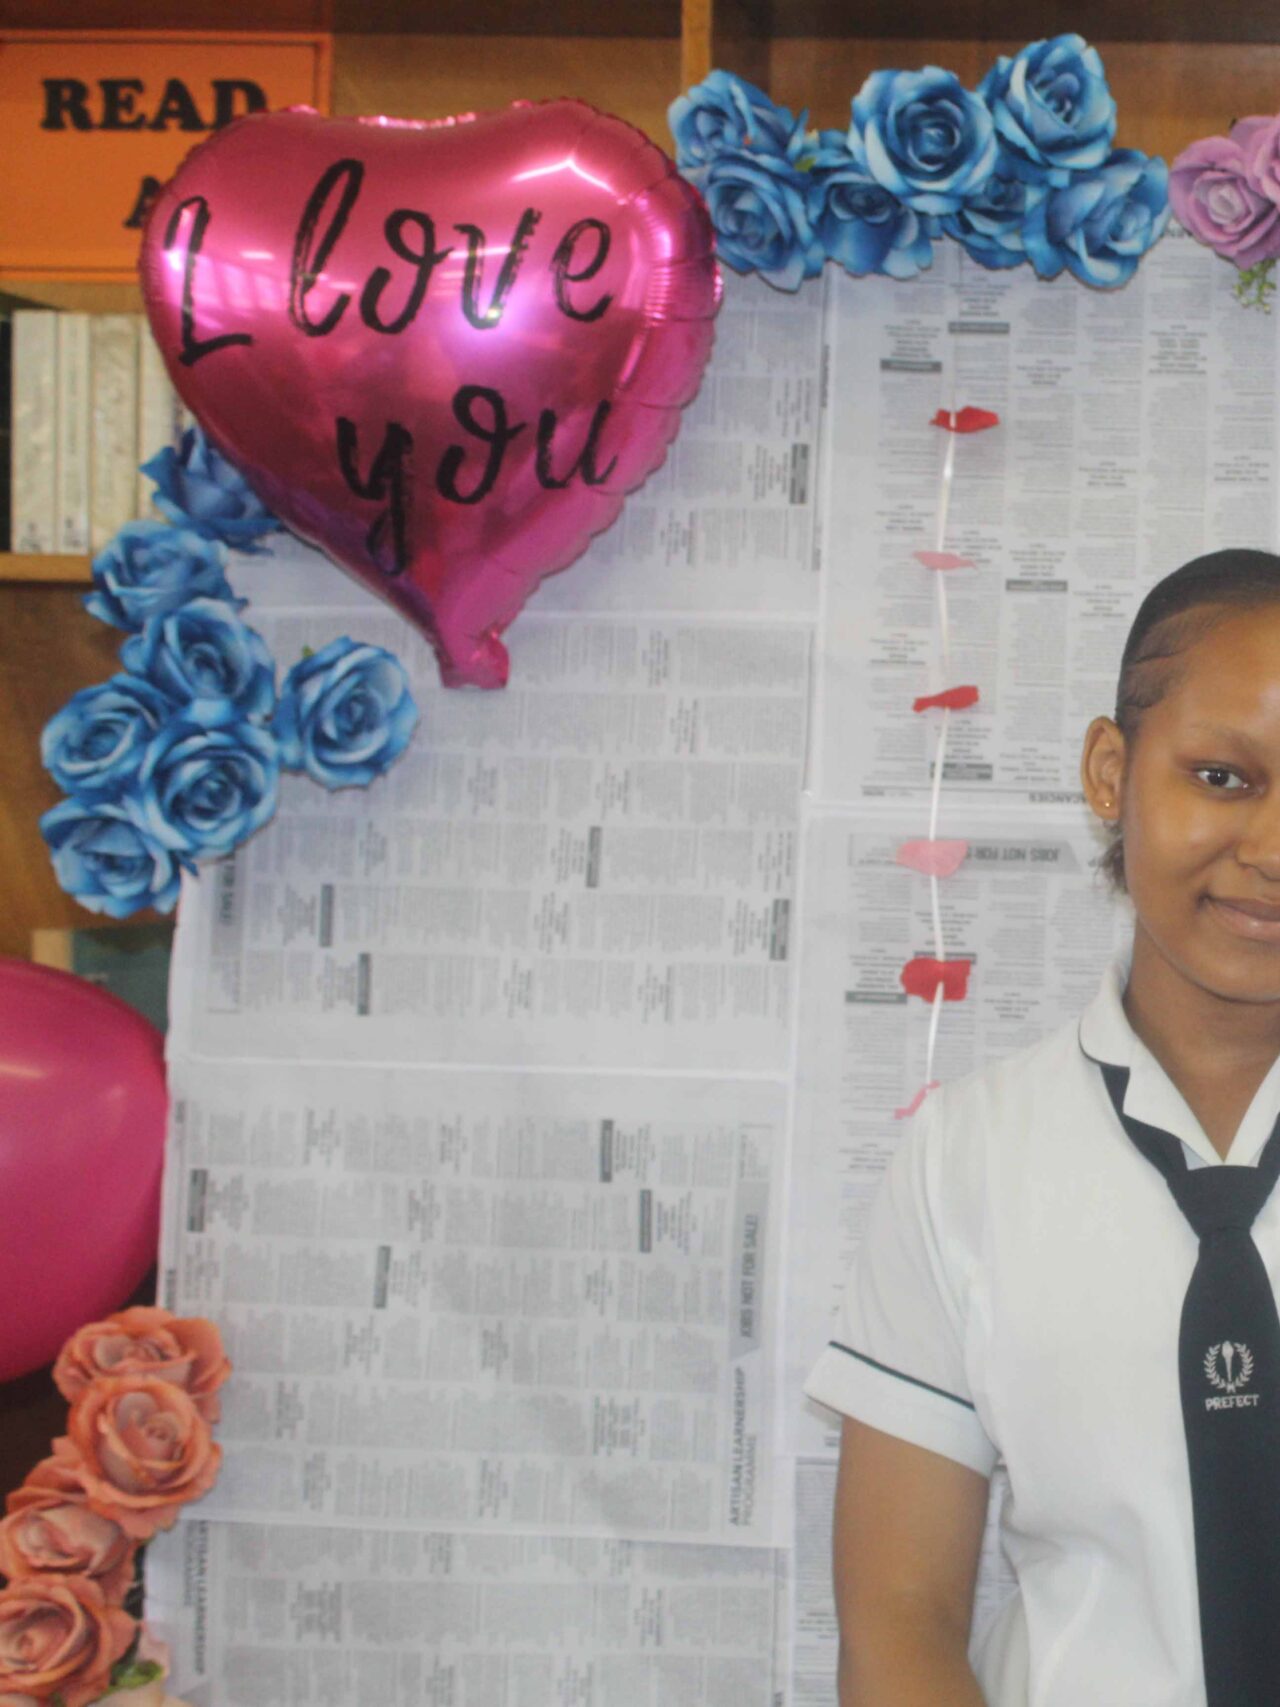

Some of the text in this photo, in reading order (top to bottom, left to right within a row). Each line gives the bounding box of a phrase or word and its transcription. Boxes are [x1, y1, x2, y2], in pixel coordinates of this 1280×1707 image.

[42, 78, 267, 131] READ
[289, 158, 614, 337] love
[336, 385, 617, 575] you
[1002, 847, 1026, 861] NOT
[1030, 847, 1061, 862] JOBS
[743, 1252, 755, 1276] FOR
[741, 1279, 754, 1304] NOT
[740, 1308, 752, 1338] JOBS
[1205, 1394, 1260, 1411] PREFECT
[730, 1367, 746, 1526] ARTISAN LEARNERSHIP
